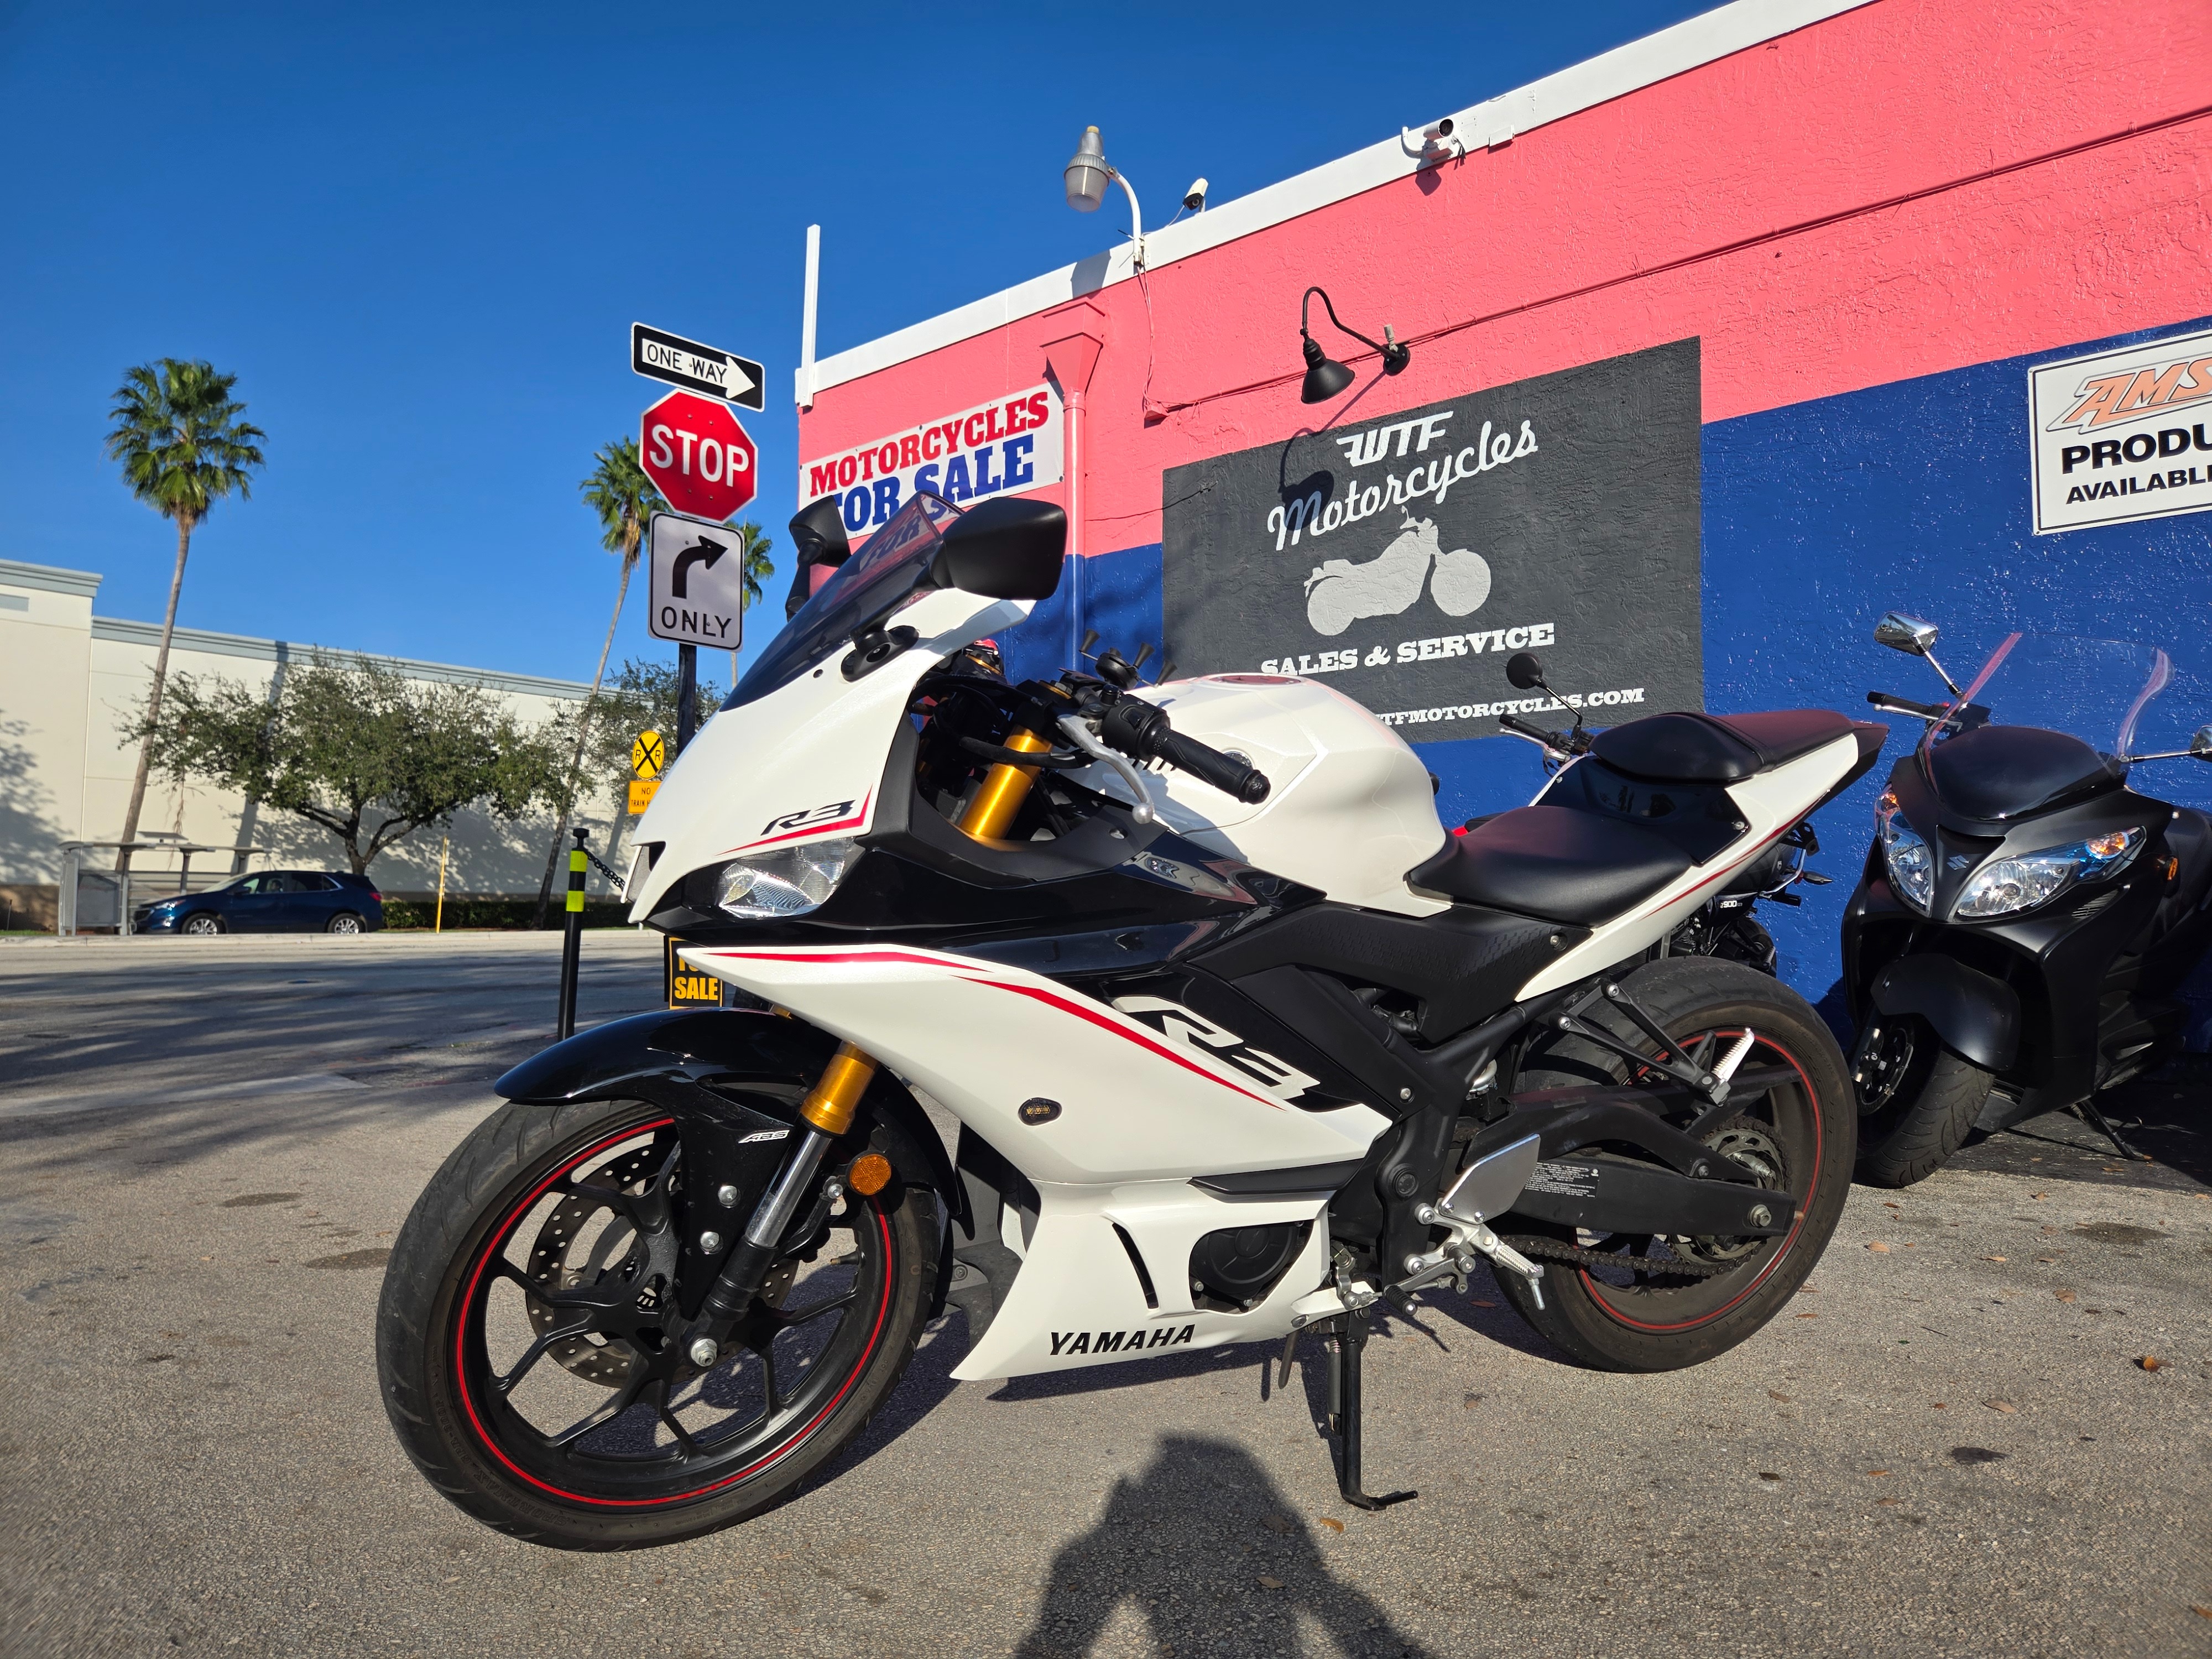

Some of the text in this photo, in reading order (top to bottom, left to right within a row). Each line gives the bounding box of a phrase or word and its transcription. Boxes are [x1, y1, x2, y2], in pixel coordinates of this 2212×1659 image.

[647, 343, 727, 384] ONE WAY
[649, 424, 749, 487] STOP
[810, 392, 1048, 497] MOTORCYCLES
[1337, 411, 1453, 467] WTF
[2062, 423, 2212, 474] PRODU
[914, 434, 1033, 503] SALE
[1267, 420, 1538, 551] Motorcycles
[661, 606, 732, 639] ONLY
[1261, 623, 1555, 676] SALES & SERVICE
[1375, 687, 1645, 726] TFMOTORCYCLES.COM
[674, 977, 718, 1000] SALE
[1050, 1324, 1196, 1355] YAMAHA
